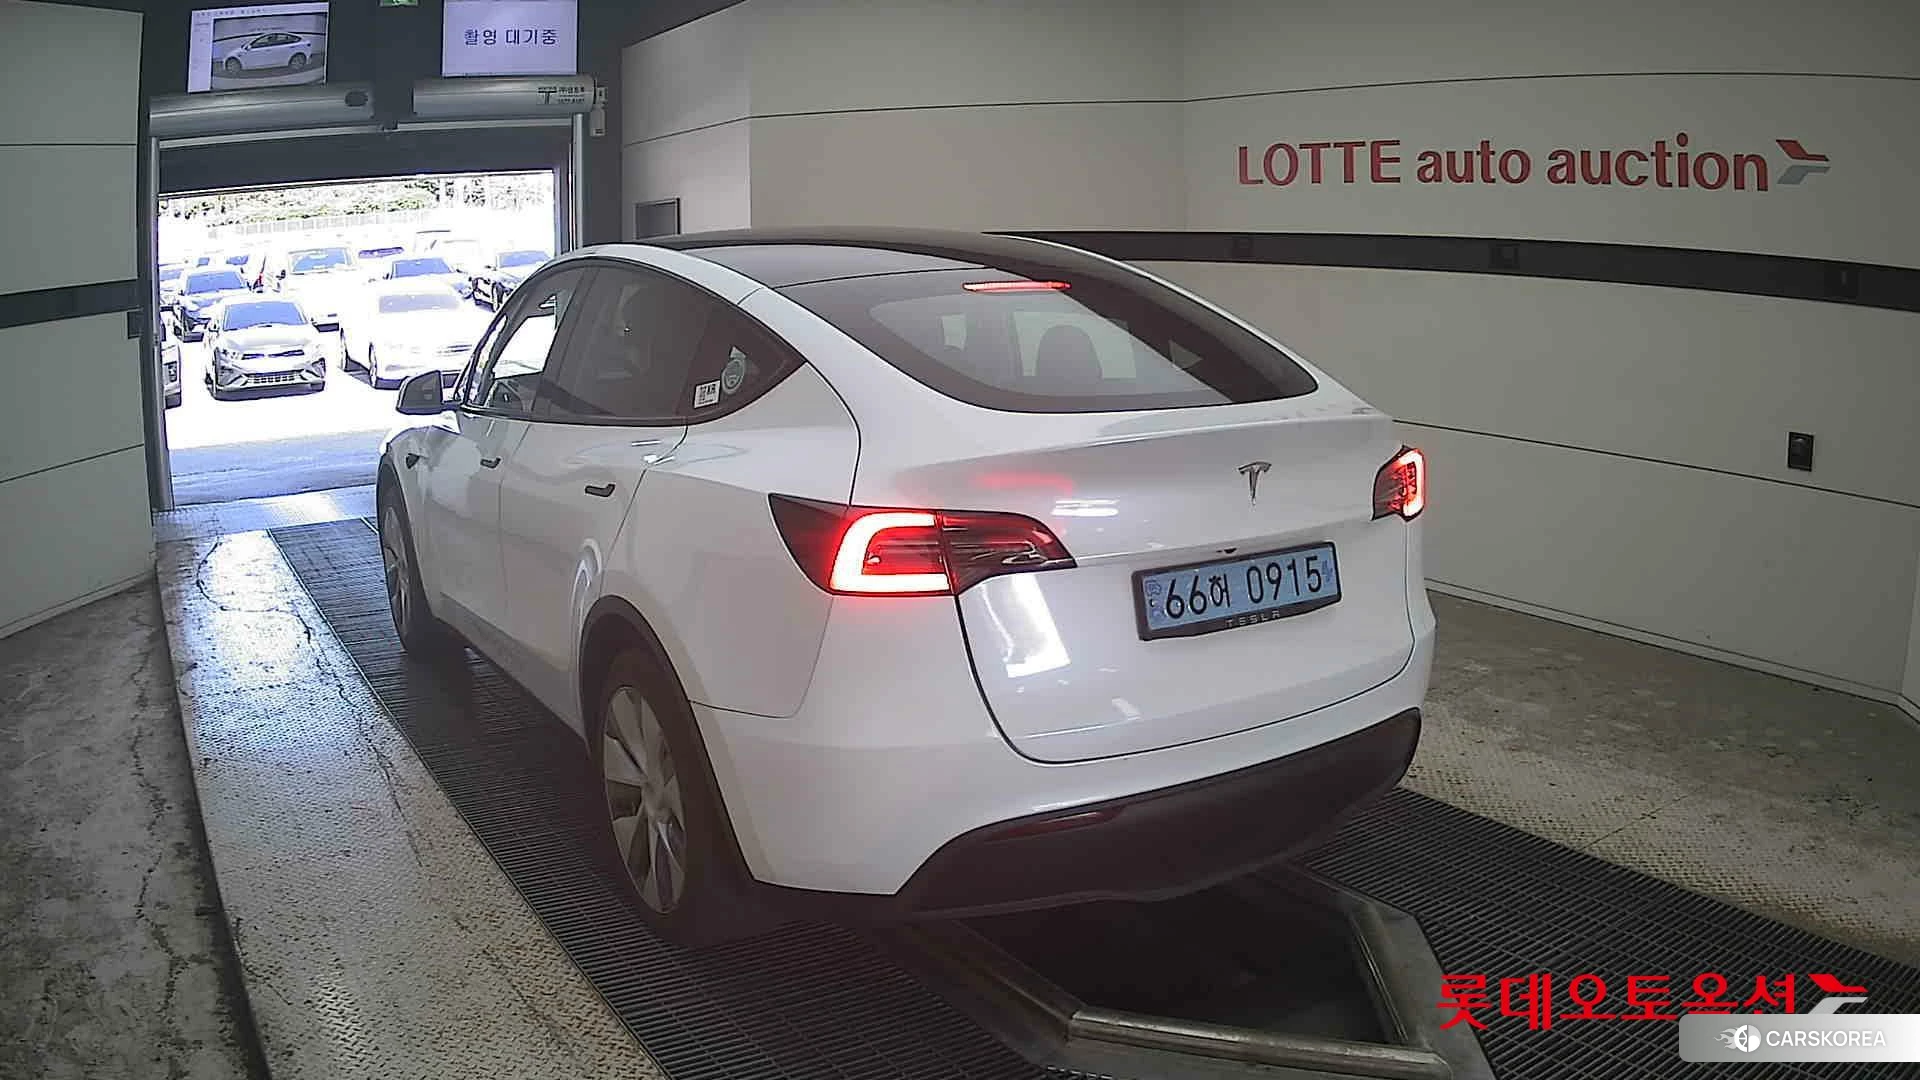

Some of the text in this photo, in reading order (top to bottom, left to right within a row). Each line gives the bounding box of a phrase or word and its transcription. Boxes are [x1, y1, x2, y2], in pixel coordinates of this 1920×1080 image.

[505, 29, 557, 46] 대기중
[1238, 132, 1768, 192] LOTTE auto auction
[1165, 573, 1231, 619] 66허
[1246, 556, 1323, 604] 0915
[1224, 609, 1281, 629] TESLA
